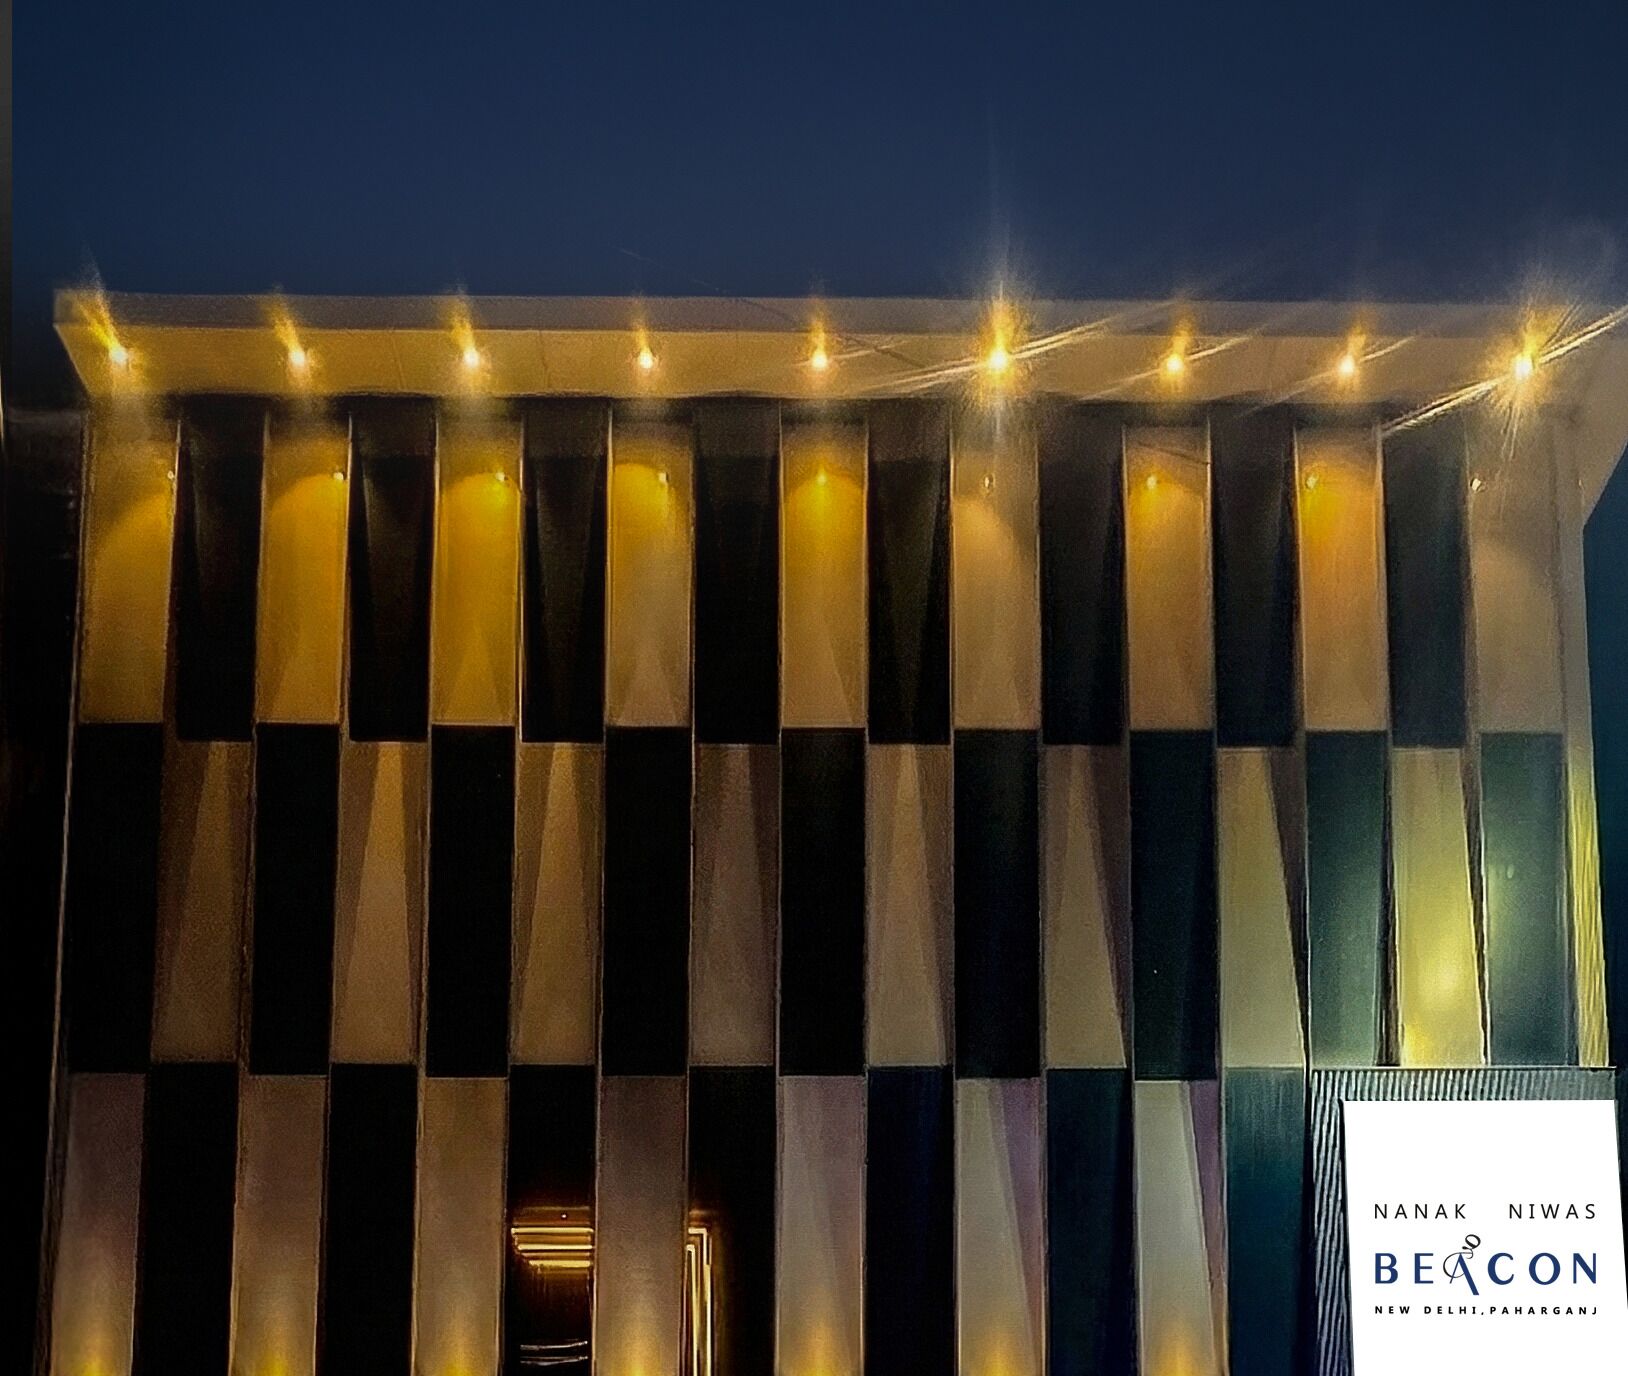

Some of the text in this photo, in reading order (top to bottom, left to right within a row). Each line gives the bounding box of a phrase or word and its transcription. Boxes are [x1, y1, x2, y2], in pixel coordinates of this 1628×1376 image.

[1374, 1203, 1596, 1220] NANAK NIWAS
[1374, 1250, 1597, 1296] BEACON
[1374, 1305, 1411, 1316] NEW
